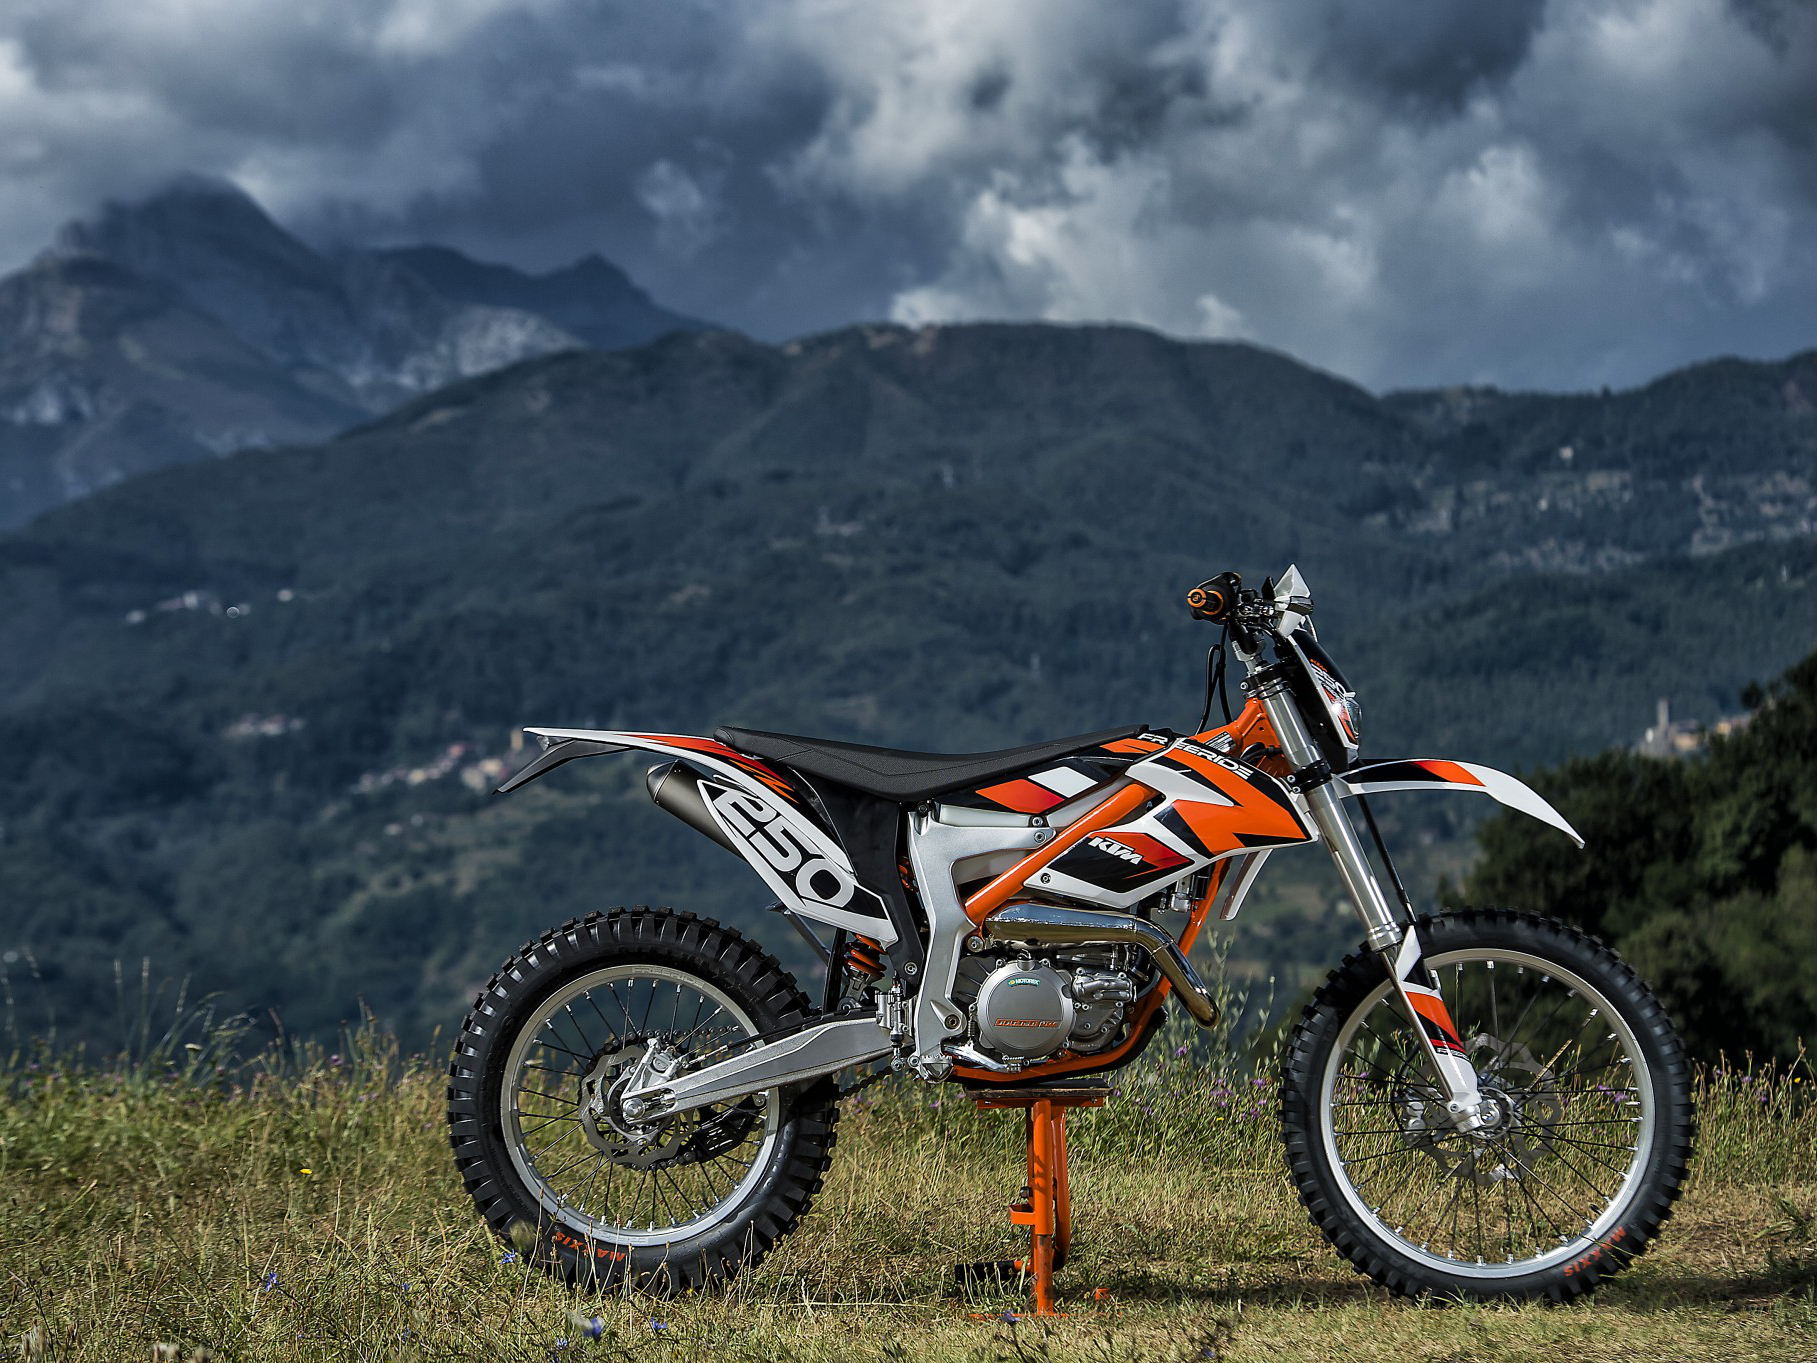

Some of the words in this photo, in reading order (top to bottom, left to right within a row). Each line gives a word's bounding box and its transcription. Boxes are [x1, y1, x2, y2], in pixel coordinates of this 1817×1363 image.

[1137, 733, 1254, 780] FREERIDE
[713, 790, 855, 908] 250
[1087, 836, 1144, 865] KTM
